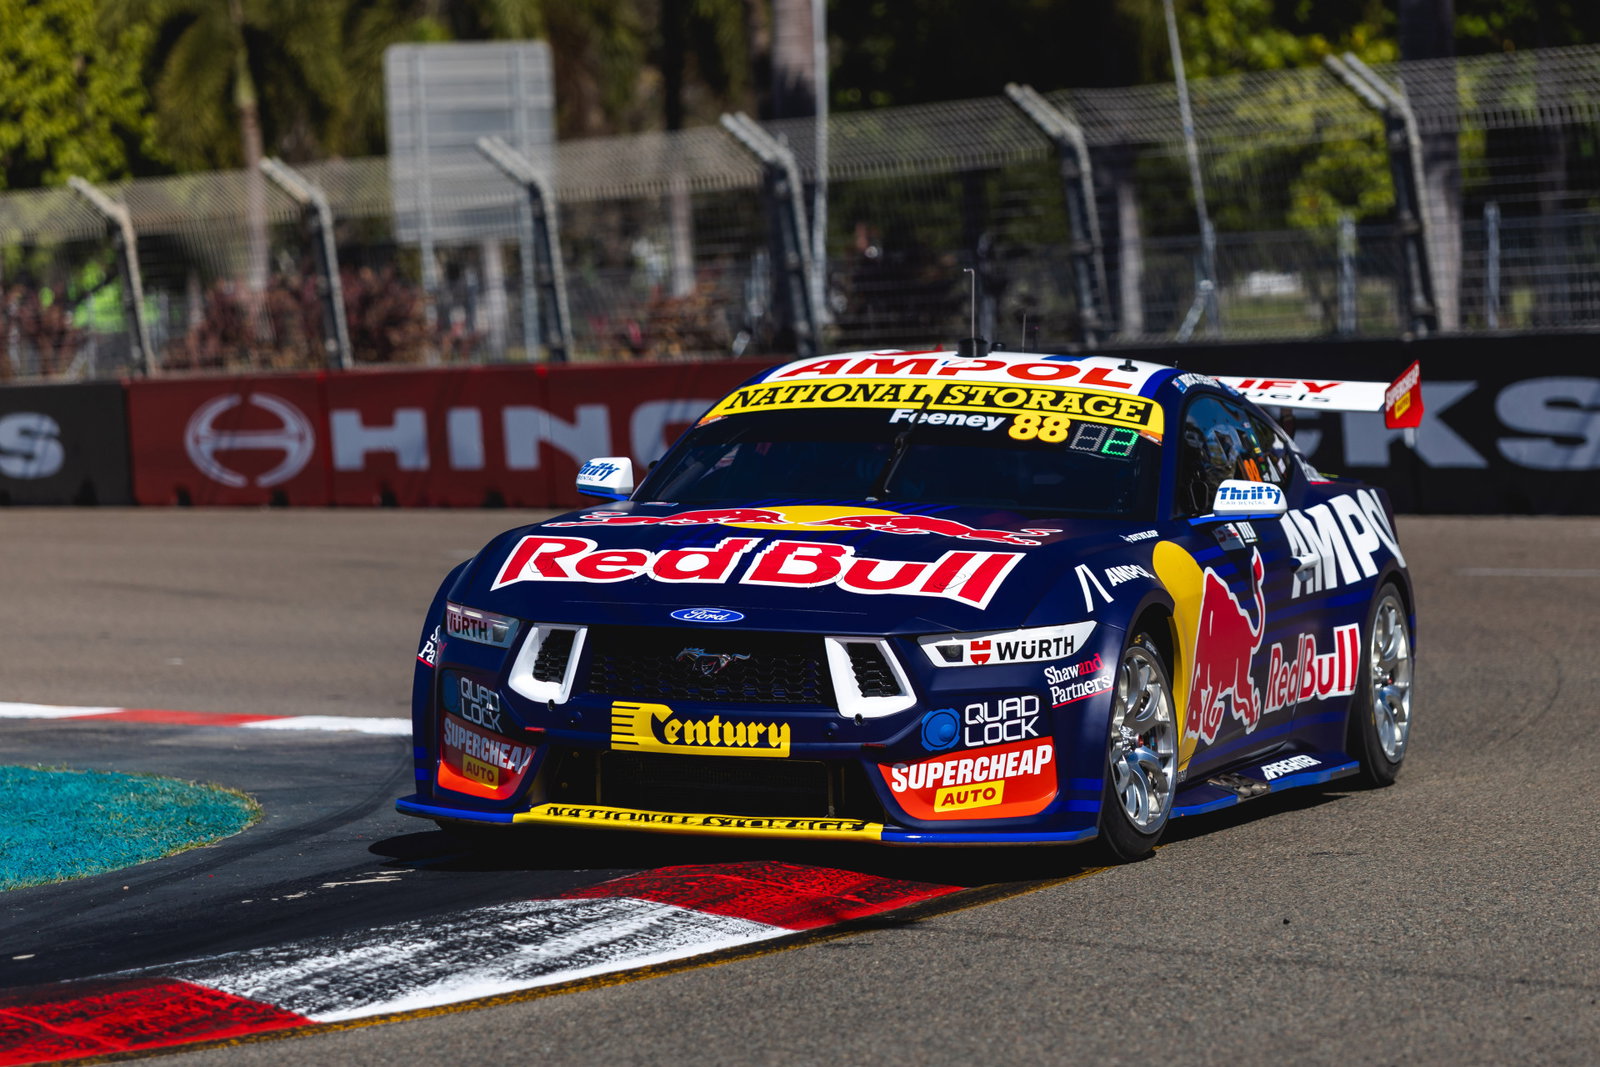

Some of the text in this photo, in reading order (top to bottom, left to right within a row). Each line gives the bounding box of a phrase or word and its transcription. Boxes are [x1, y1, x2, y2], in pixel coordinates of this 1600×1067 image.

[775, 359, 1132, 389] AMPOL
[1238, 379, 1343, 393] IFY
[724, 383, 1149, 423] NATIONAL STORAGE
[889, 408, 1071, 443] Feeney 88
[579, 460, 621, 481] hrifty
[1218, 486, 1281, 505] Thrifty
[493, 536, 1026, 609] Red Bull
[683, 609, 731, 621] Ford
[996, 635, 1075, 661] WÜRTH
[1265, 625, 1361, 712] Red Bull
[461, 677, 500, 713] QUAD
[1050, 673, 1113, 706] Partners
[461, 698, 503, 733] LOCK
[964, 695, 1040, 724] QUAD
[612, 701, 791, 757] Century
[964, 716, 1040, 747] LOCK
[466, 761, 495, 782] AUTO
[891, 744, 1053, 793] SUPERCHEAP
[942, 787, 996, 807] AUTO
